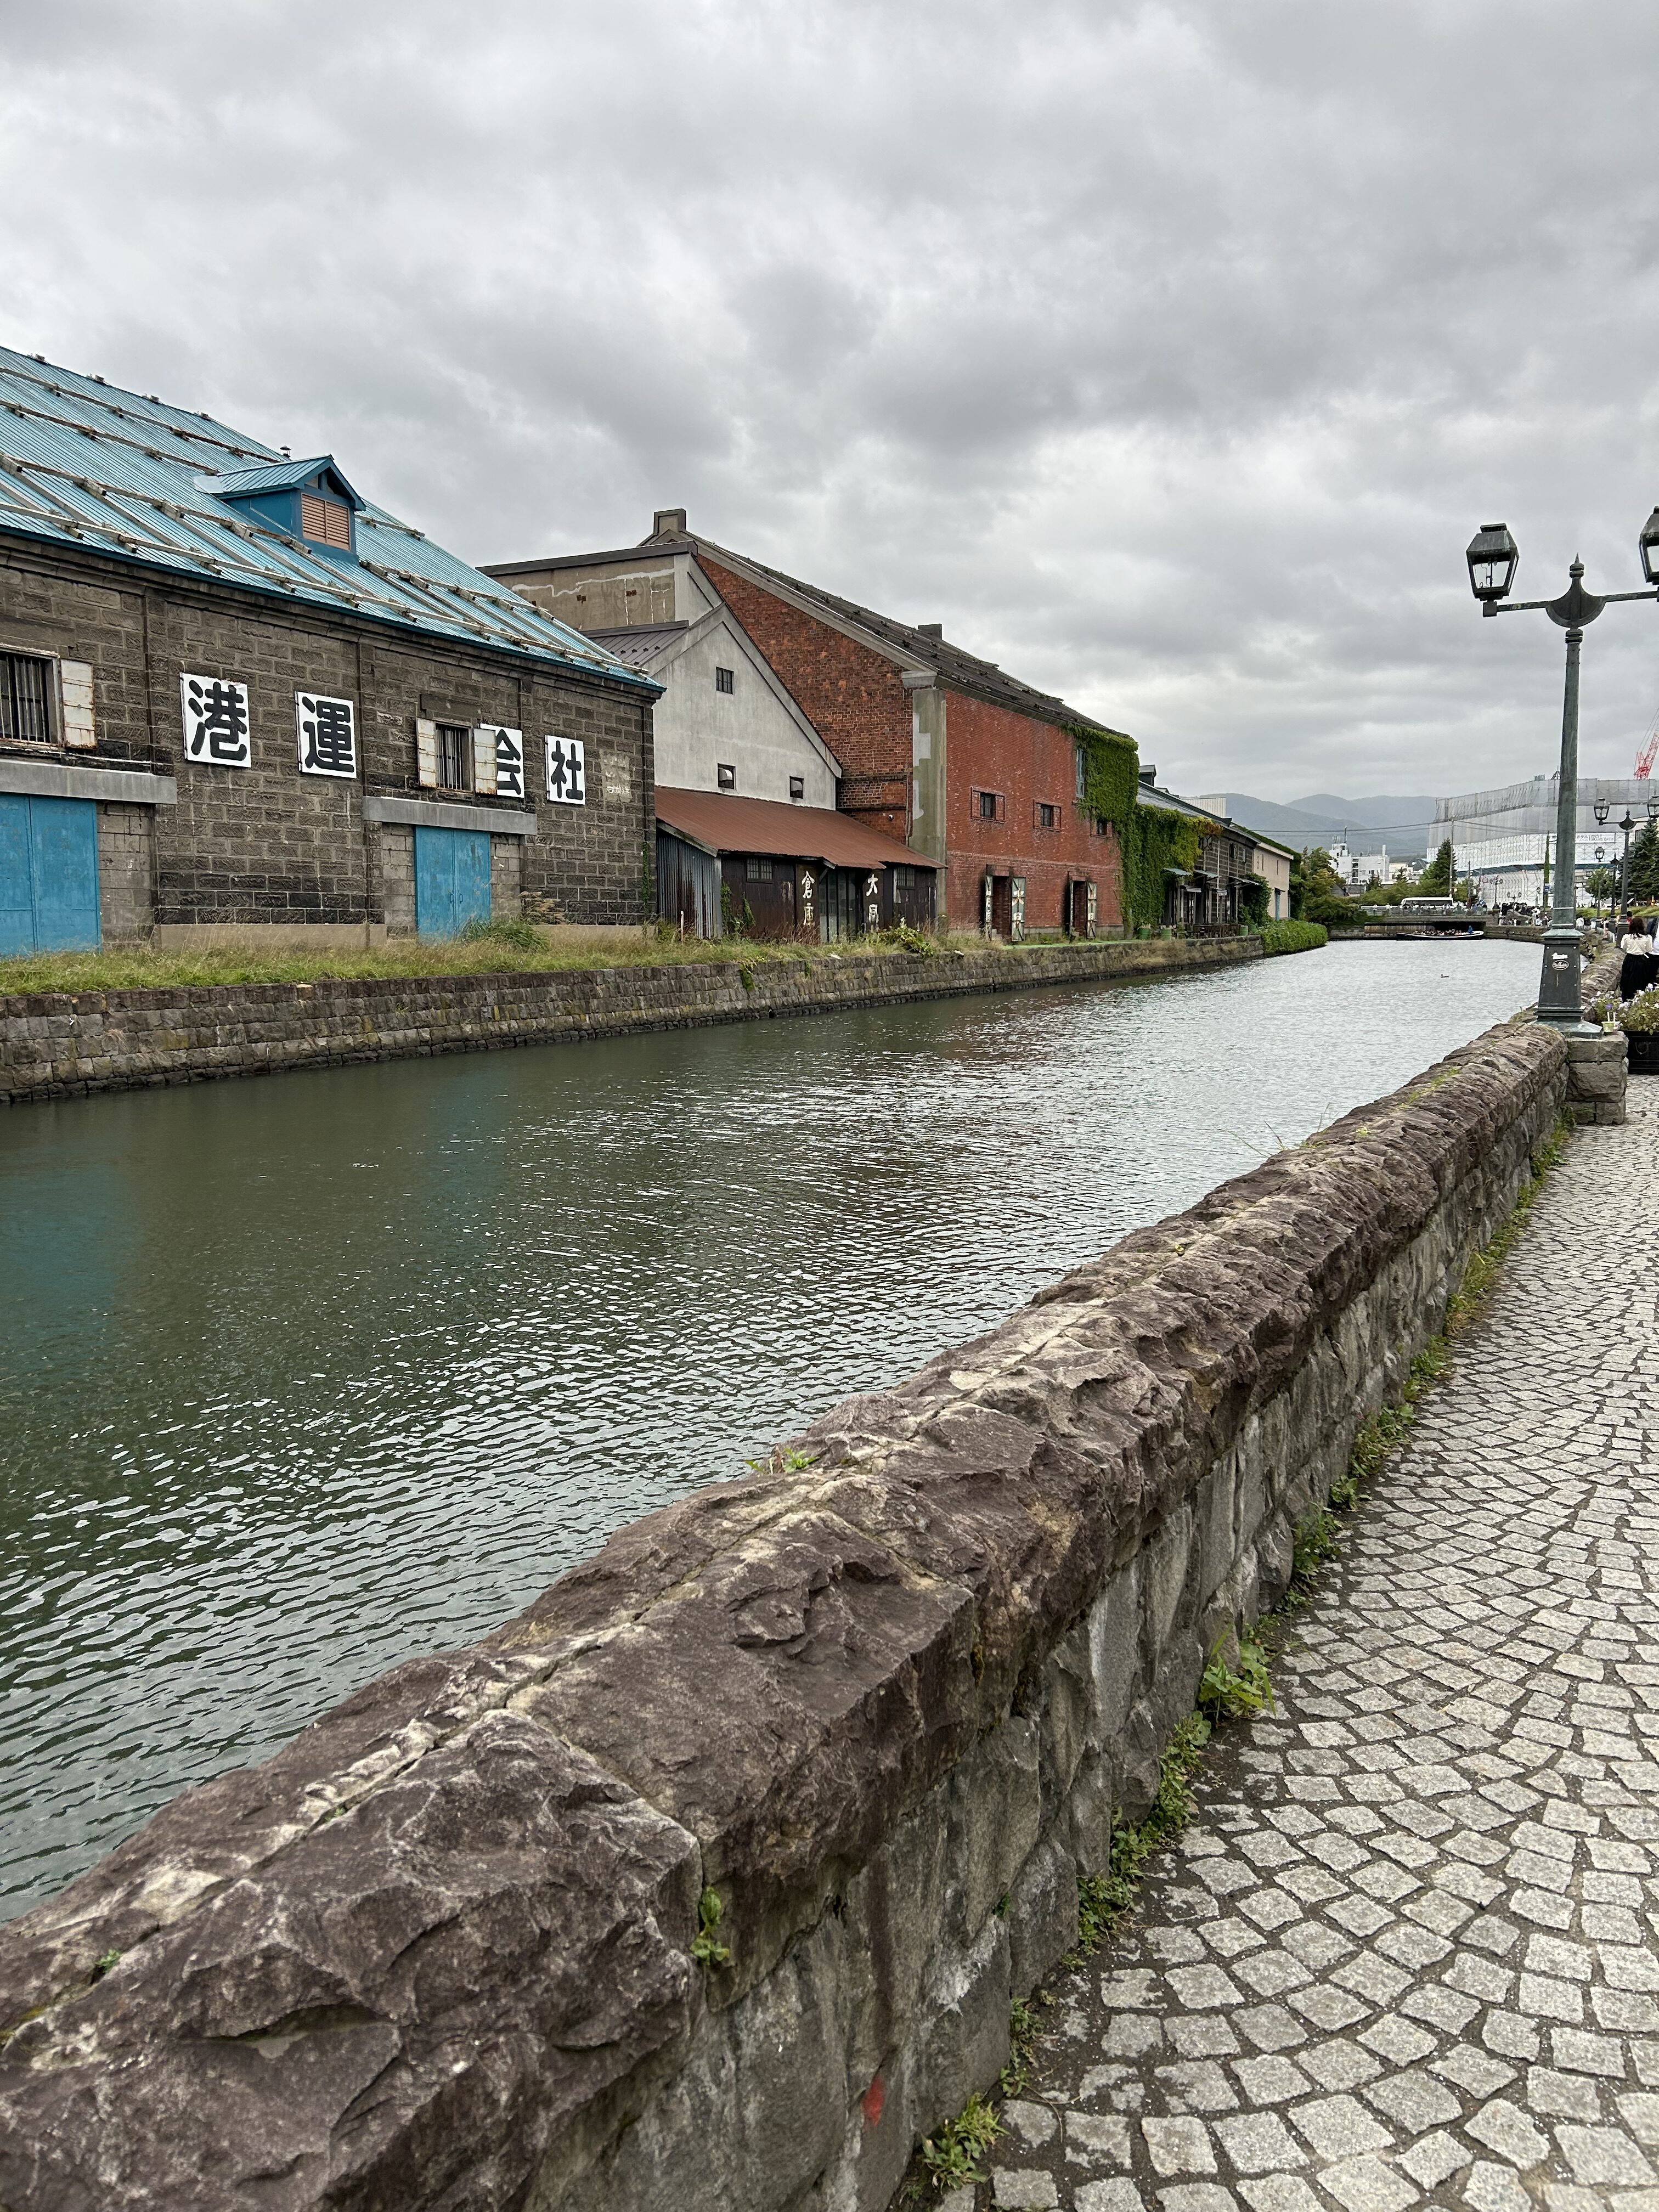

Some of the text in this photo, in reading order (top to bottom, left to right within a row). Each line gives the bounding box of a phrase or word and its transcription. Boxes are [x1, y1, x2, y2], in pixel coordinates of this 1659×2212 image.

[188, 680, 247, 761] 港
[302, 696, 355, 773] 運
[551, 740, 583, 800] 社
